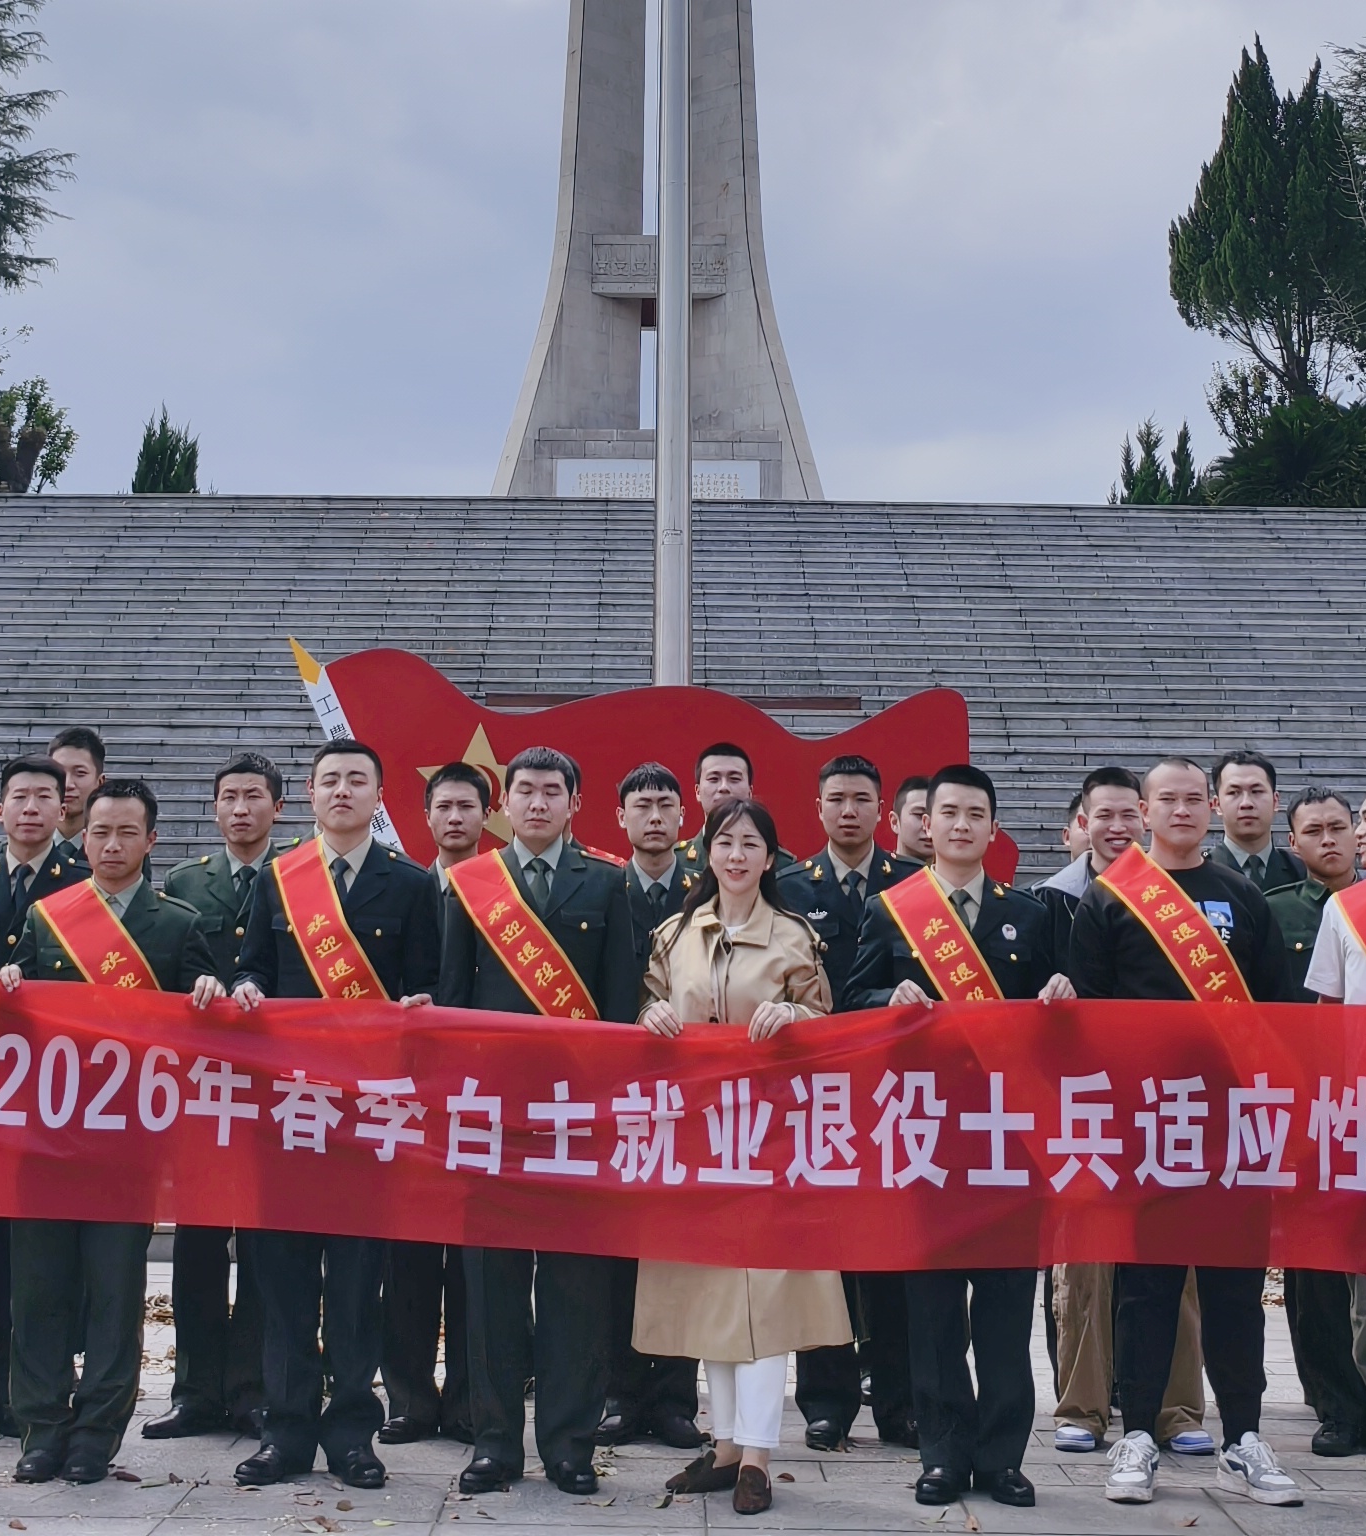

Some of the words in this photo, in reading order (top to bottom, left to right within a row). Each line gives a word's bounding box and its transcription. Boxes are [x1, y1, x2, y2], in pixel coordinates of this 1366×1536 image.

[100, 951, 142, 989] 欢迎
[307, 913, 370, 999] 欢迎退役
[1140, 884, 1239, 1002] 欢迎退役士
